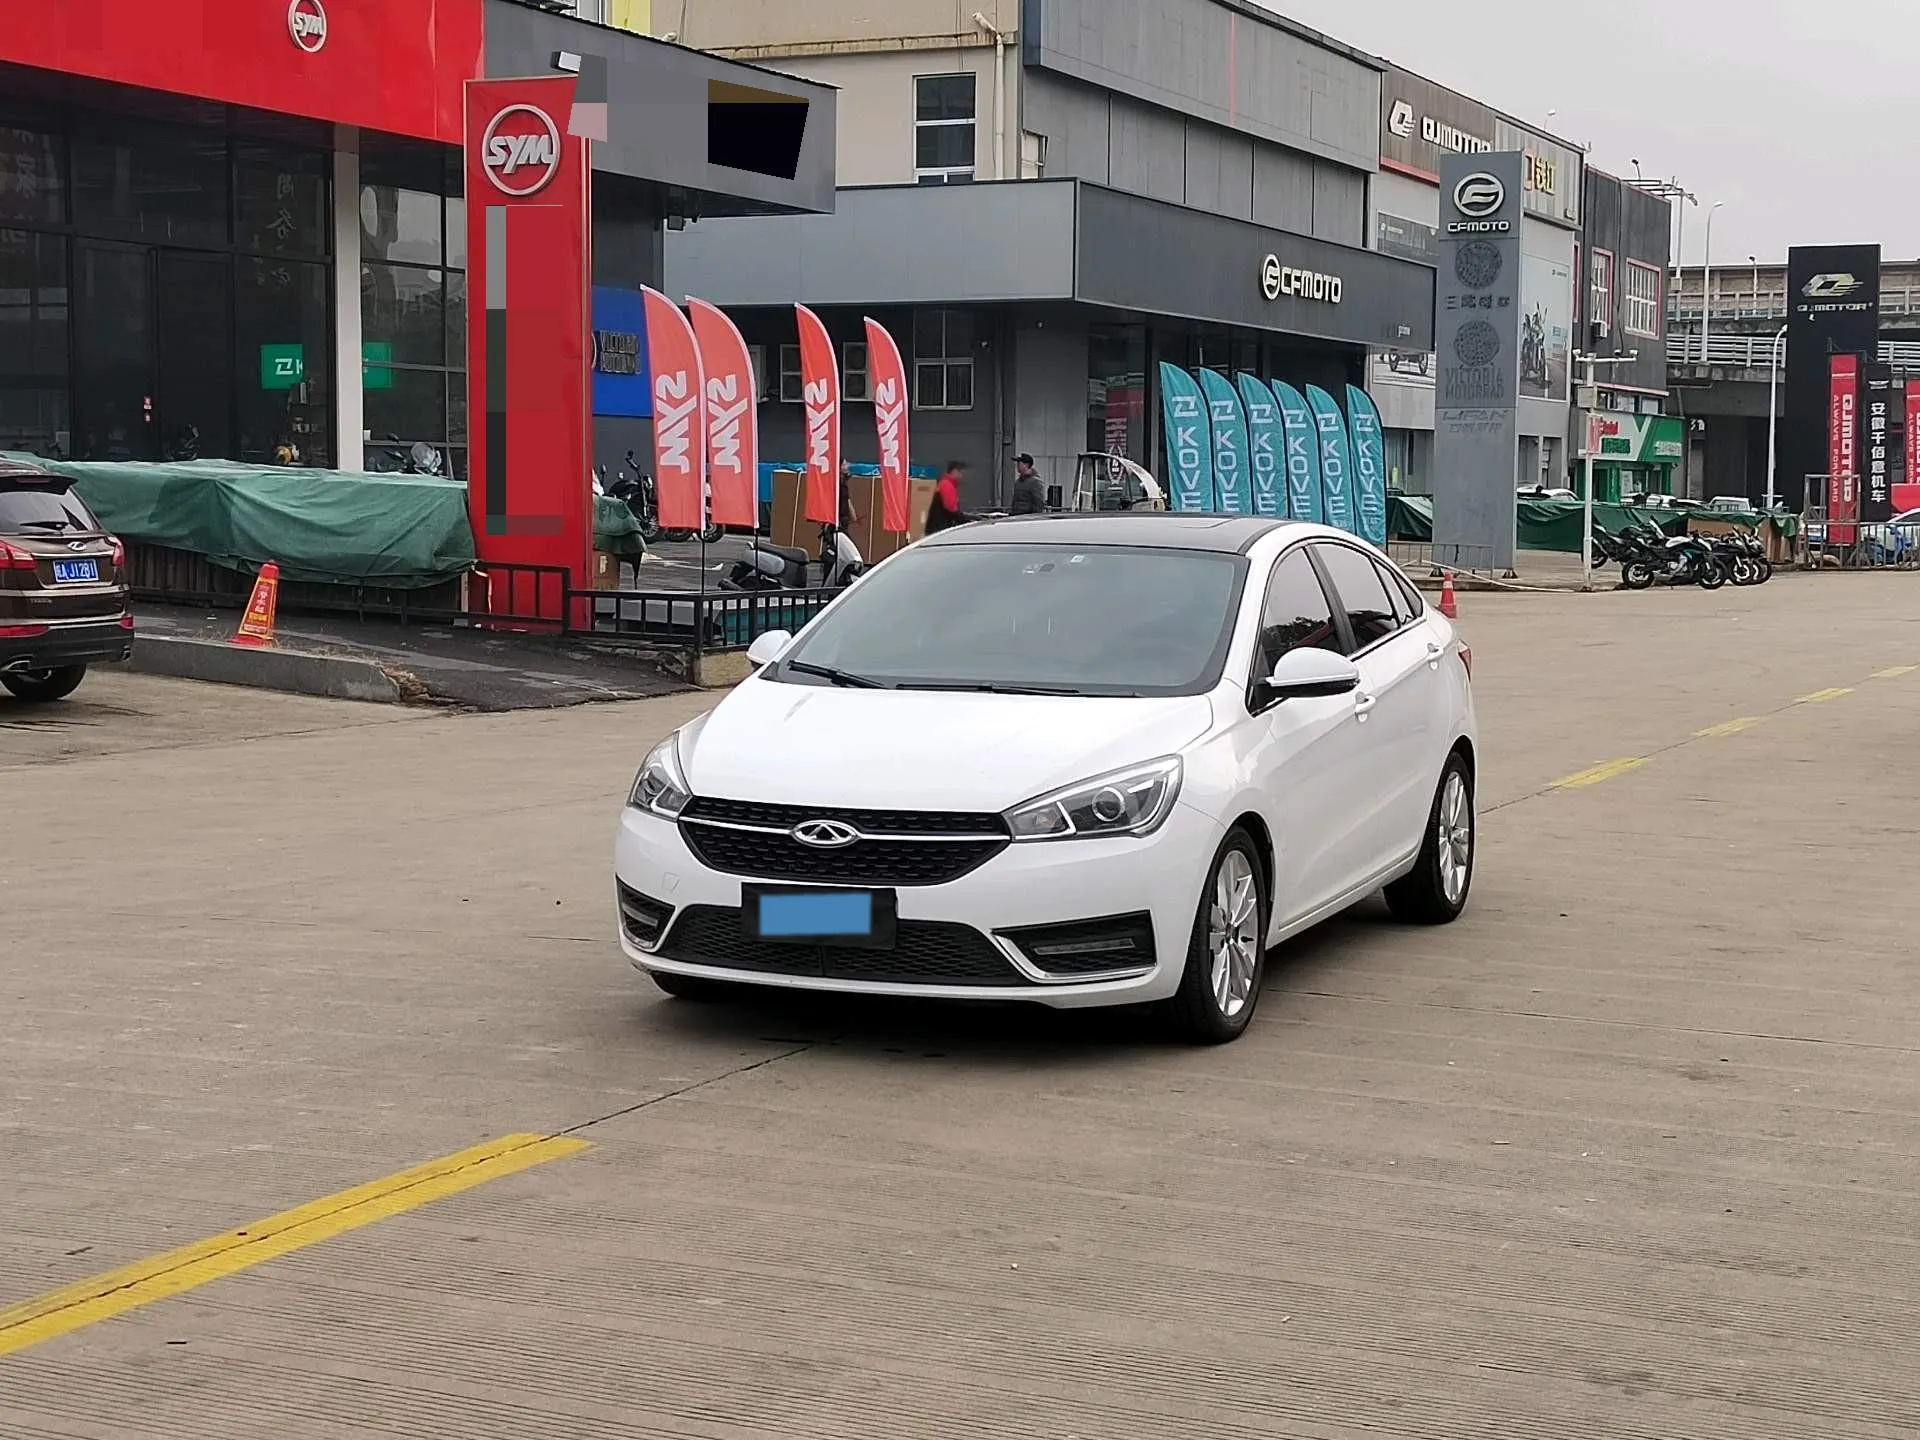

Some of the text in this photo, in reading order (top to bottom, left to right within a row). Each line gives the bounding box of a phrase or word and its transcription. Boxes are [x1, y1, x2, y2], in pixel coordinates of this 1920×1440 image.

[293, 11, 324, 37] SYM
[486, 134, 554, 174] SYM
[1447, 220, 1510, 232] CFMOTO
[1280, 266, 1342, 303] CFMOTO
[655, 370, 697, 475] SYM
[706, 374, 748, 474] SYM
[804, 378, 834, 474] SYM
[875, 378, 903, 474] SYM
[1841, 394, 1853, 502] QJMOTOR
[1177, 426, 1201, 512] KOVE
[1215, 429, 1240, 512] KOVE
[1253, 432, 1277, 513] KOVE
[1288, 436, 1312, 513] KOVE
[1321, 439, 1347, 514] KOVE
[1358, 440, 1379, 512] KOVE
